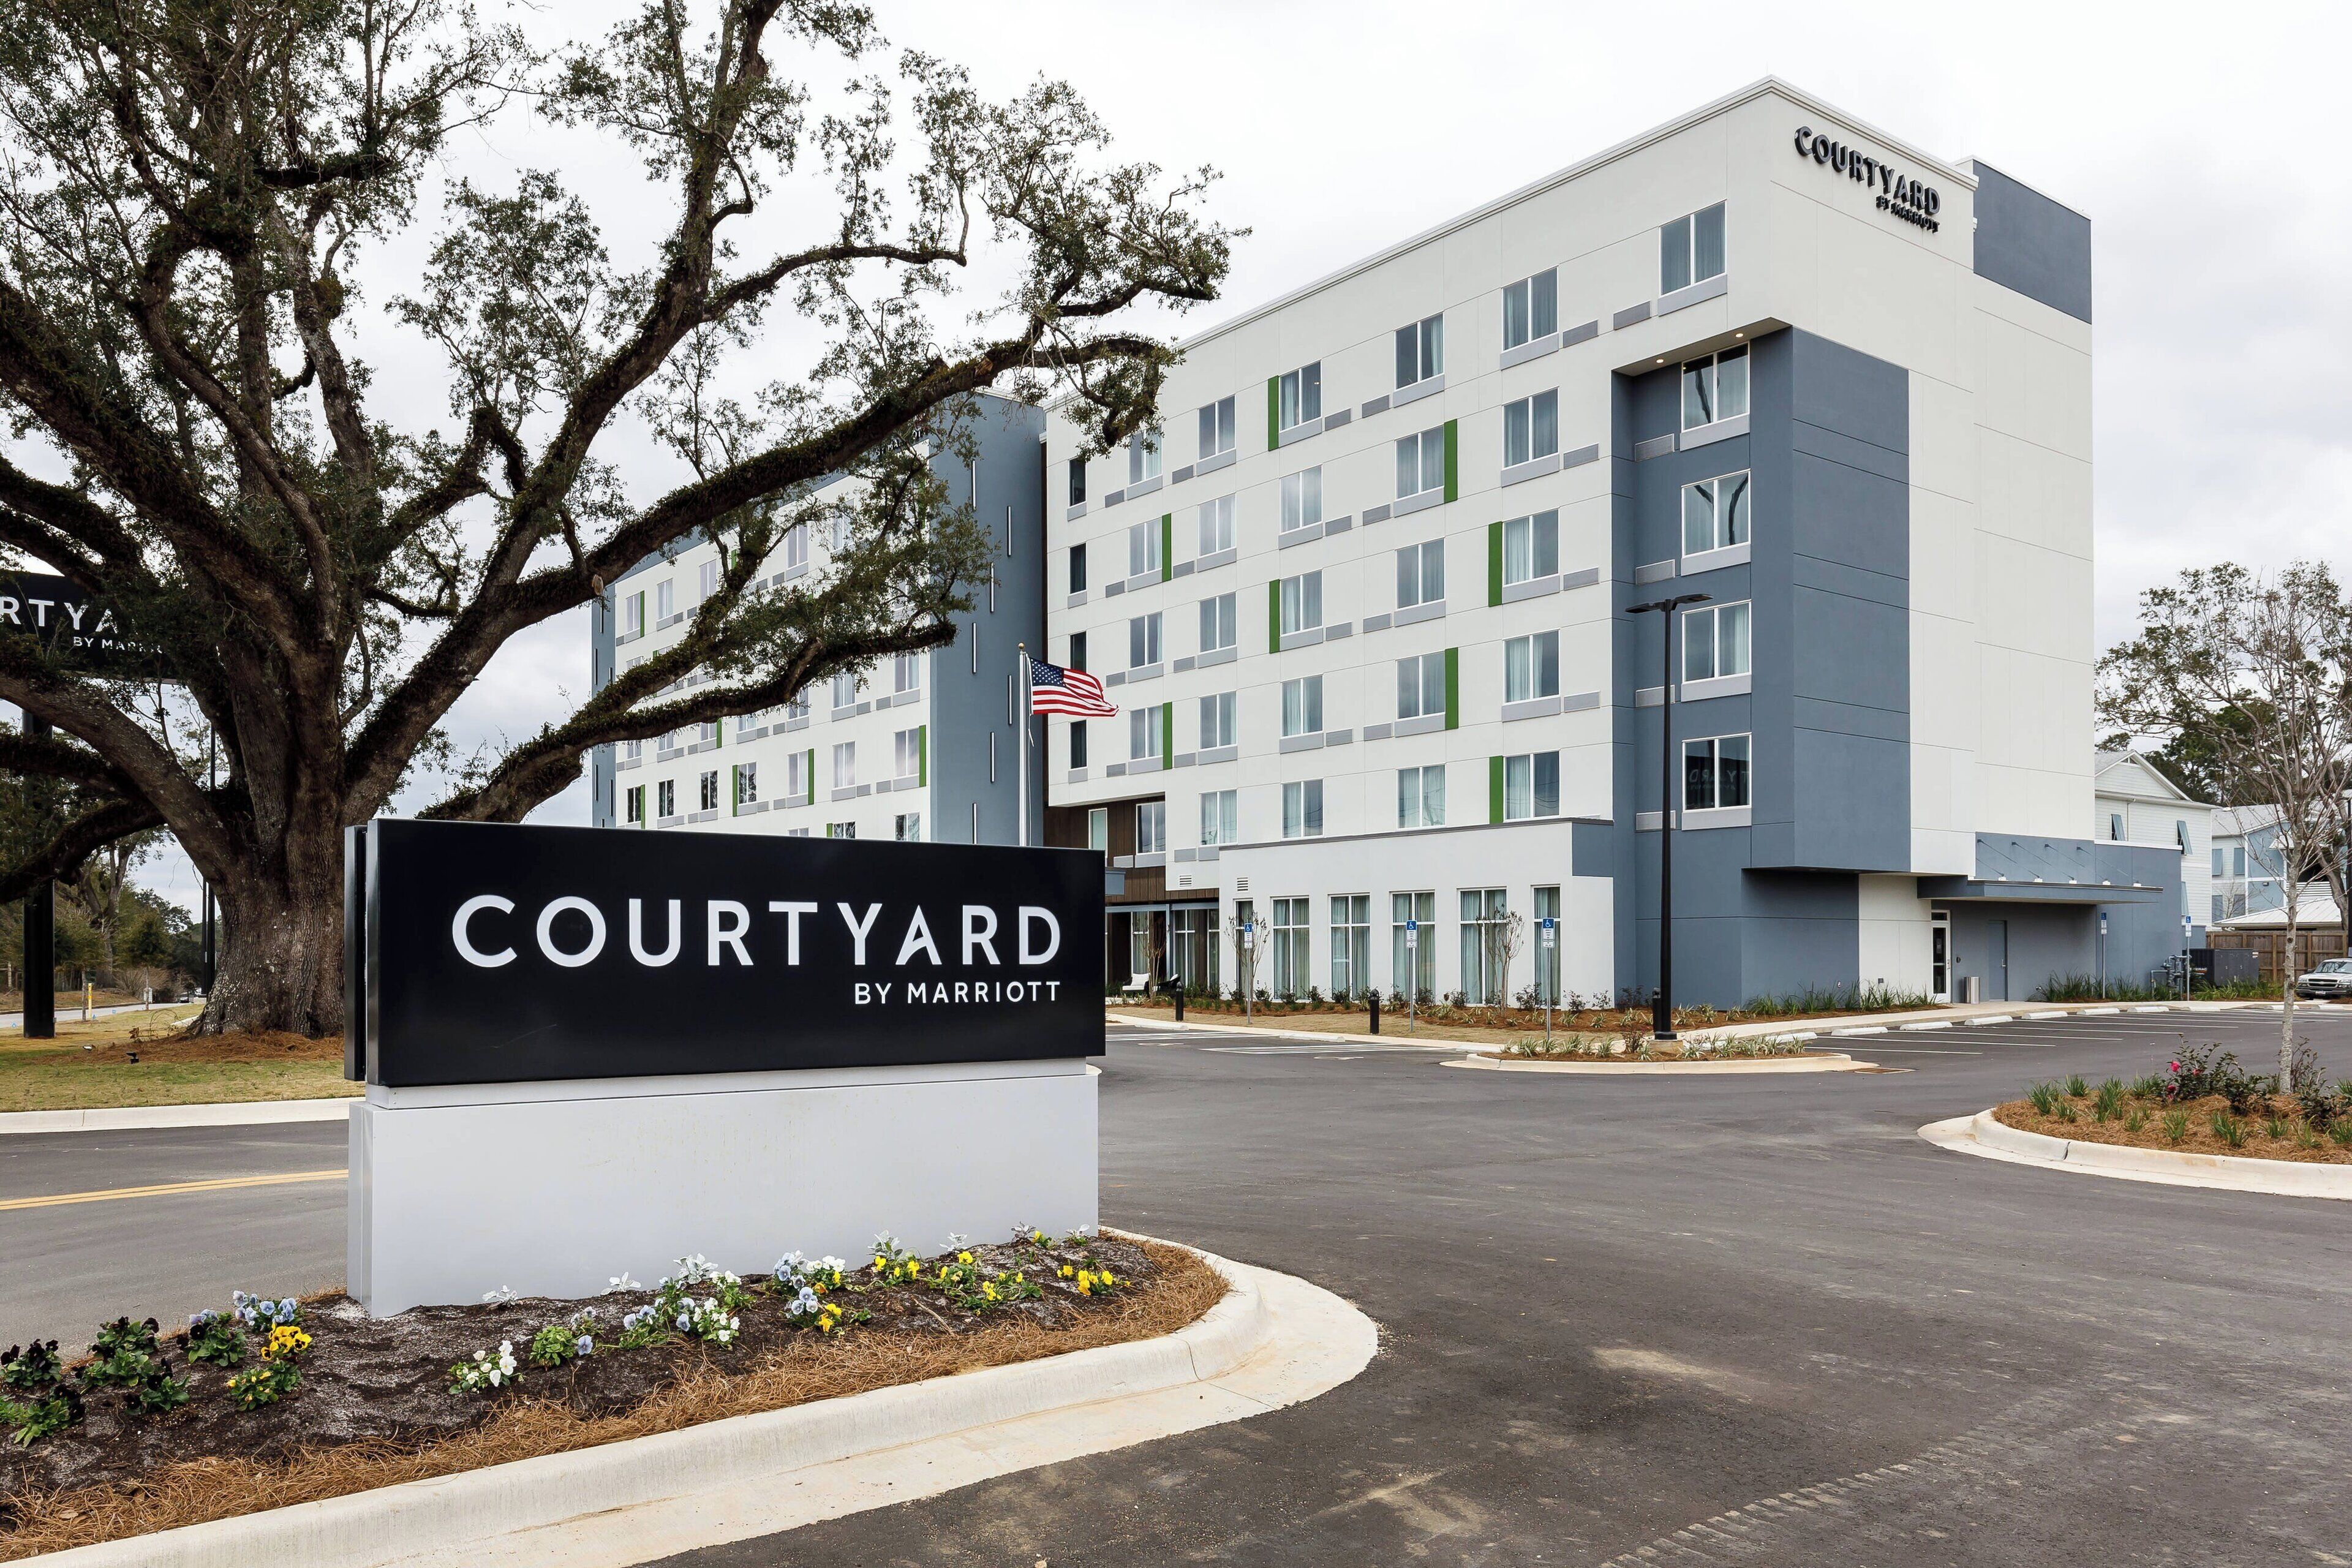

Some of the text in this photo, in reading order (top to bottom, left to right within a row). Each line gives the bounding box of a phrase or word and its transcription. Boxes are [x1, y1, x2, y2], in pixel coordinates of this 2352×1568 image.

[1794, 126, 1940, 216] COURTYARD
[1875, 195, 1940, 233] BY MARRIOTT
[0, 595, 141, 635] RTYA
[73, 636, 94, 647] BY
[452, 894, 1060, 968] COURTYARD
[854, 981, 1060, 1005] BY MARRIOTT
